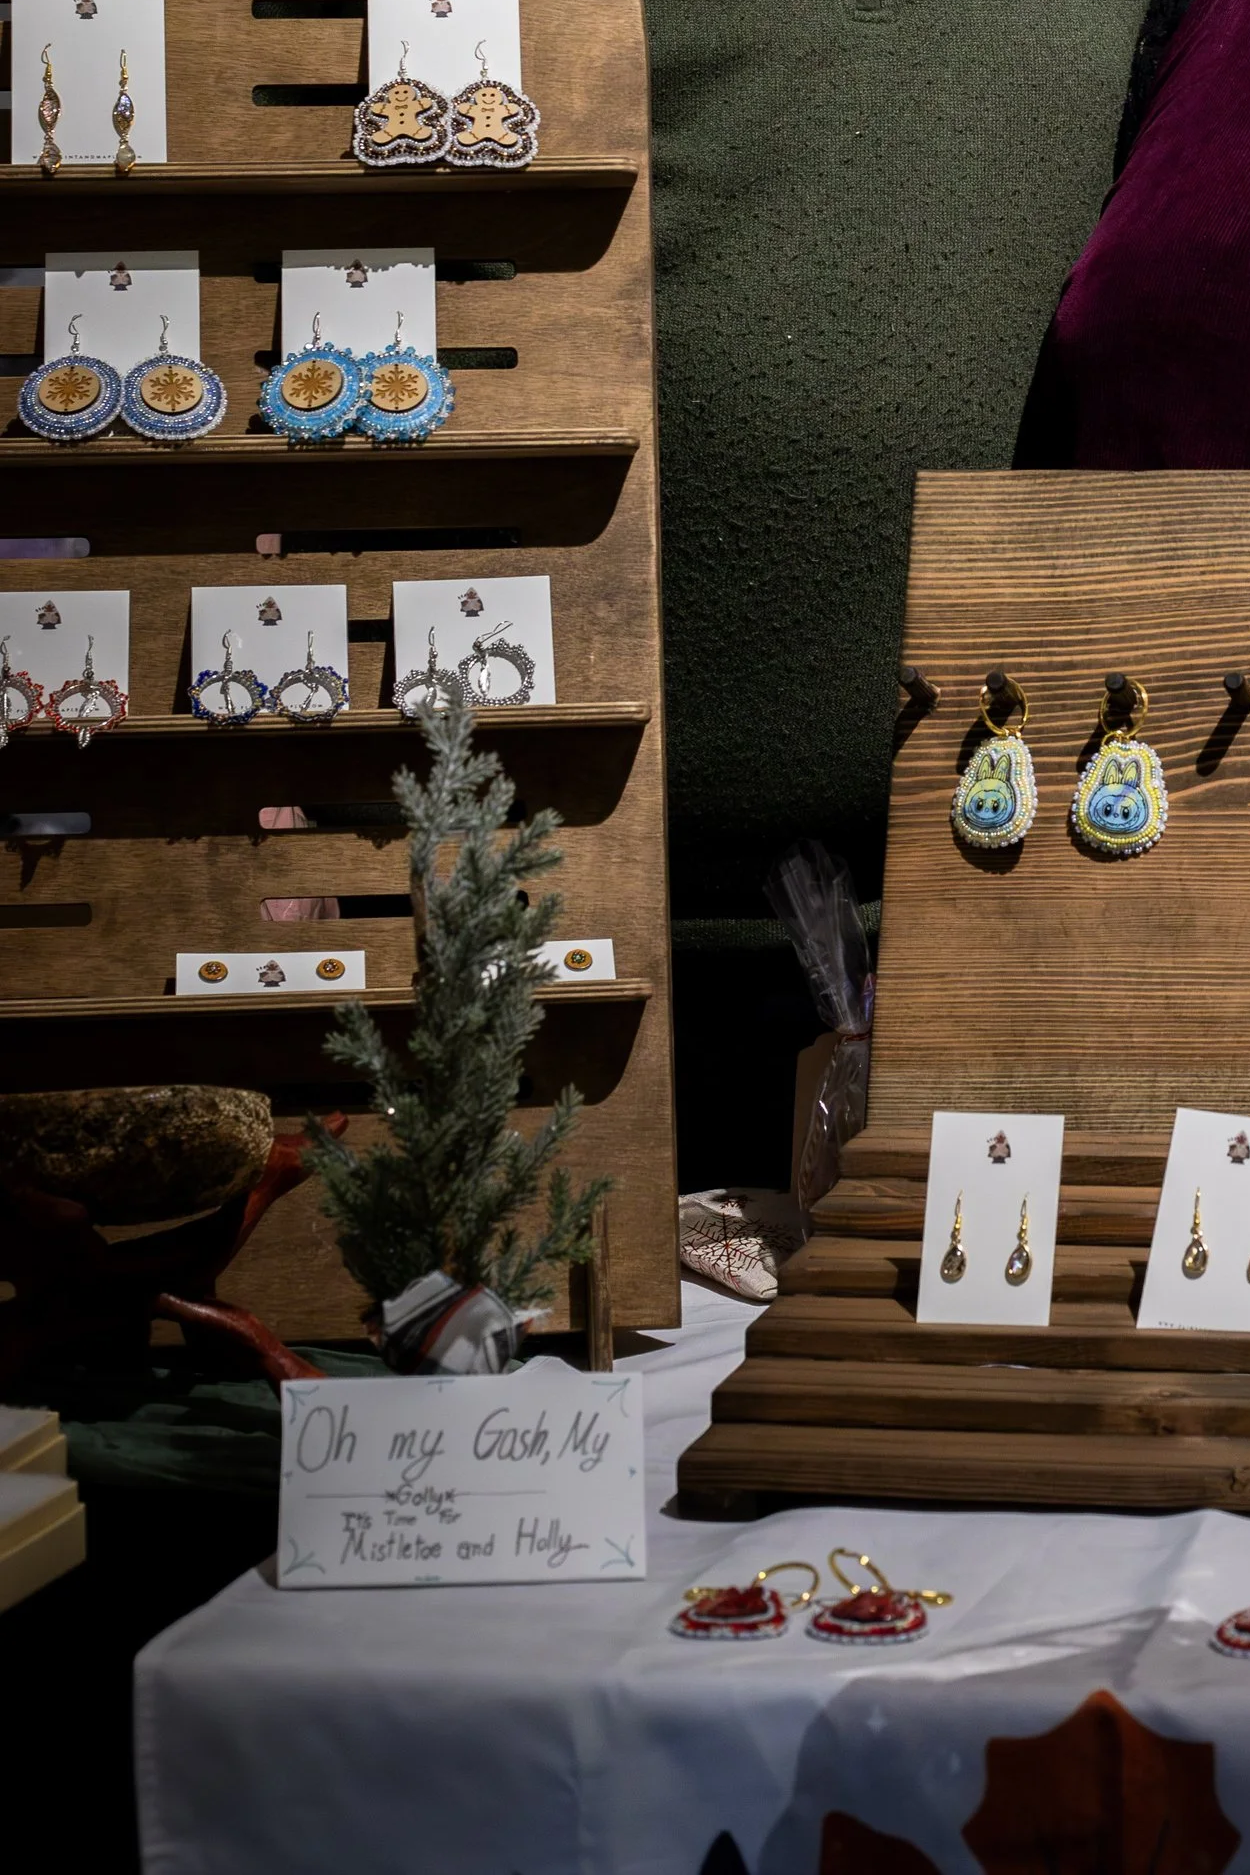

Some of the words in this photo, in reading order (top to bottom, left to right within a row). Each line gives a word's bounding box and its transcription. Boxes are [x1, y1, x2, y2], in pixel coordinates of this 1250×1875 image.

[297, 1404, 357, 1474] Oh
[388, 1429, 445, 1483] my
[557, 1410, 611, 1472] My
[340, 1528, 442, 1565] Mistletoe
[456, 1533, 496, 1561] and
[515, 1516, 590, 1568] Holly
